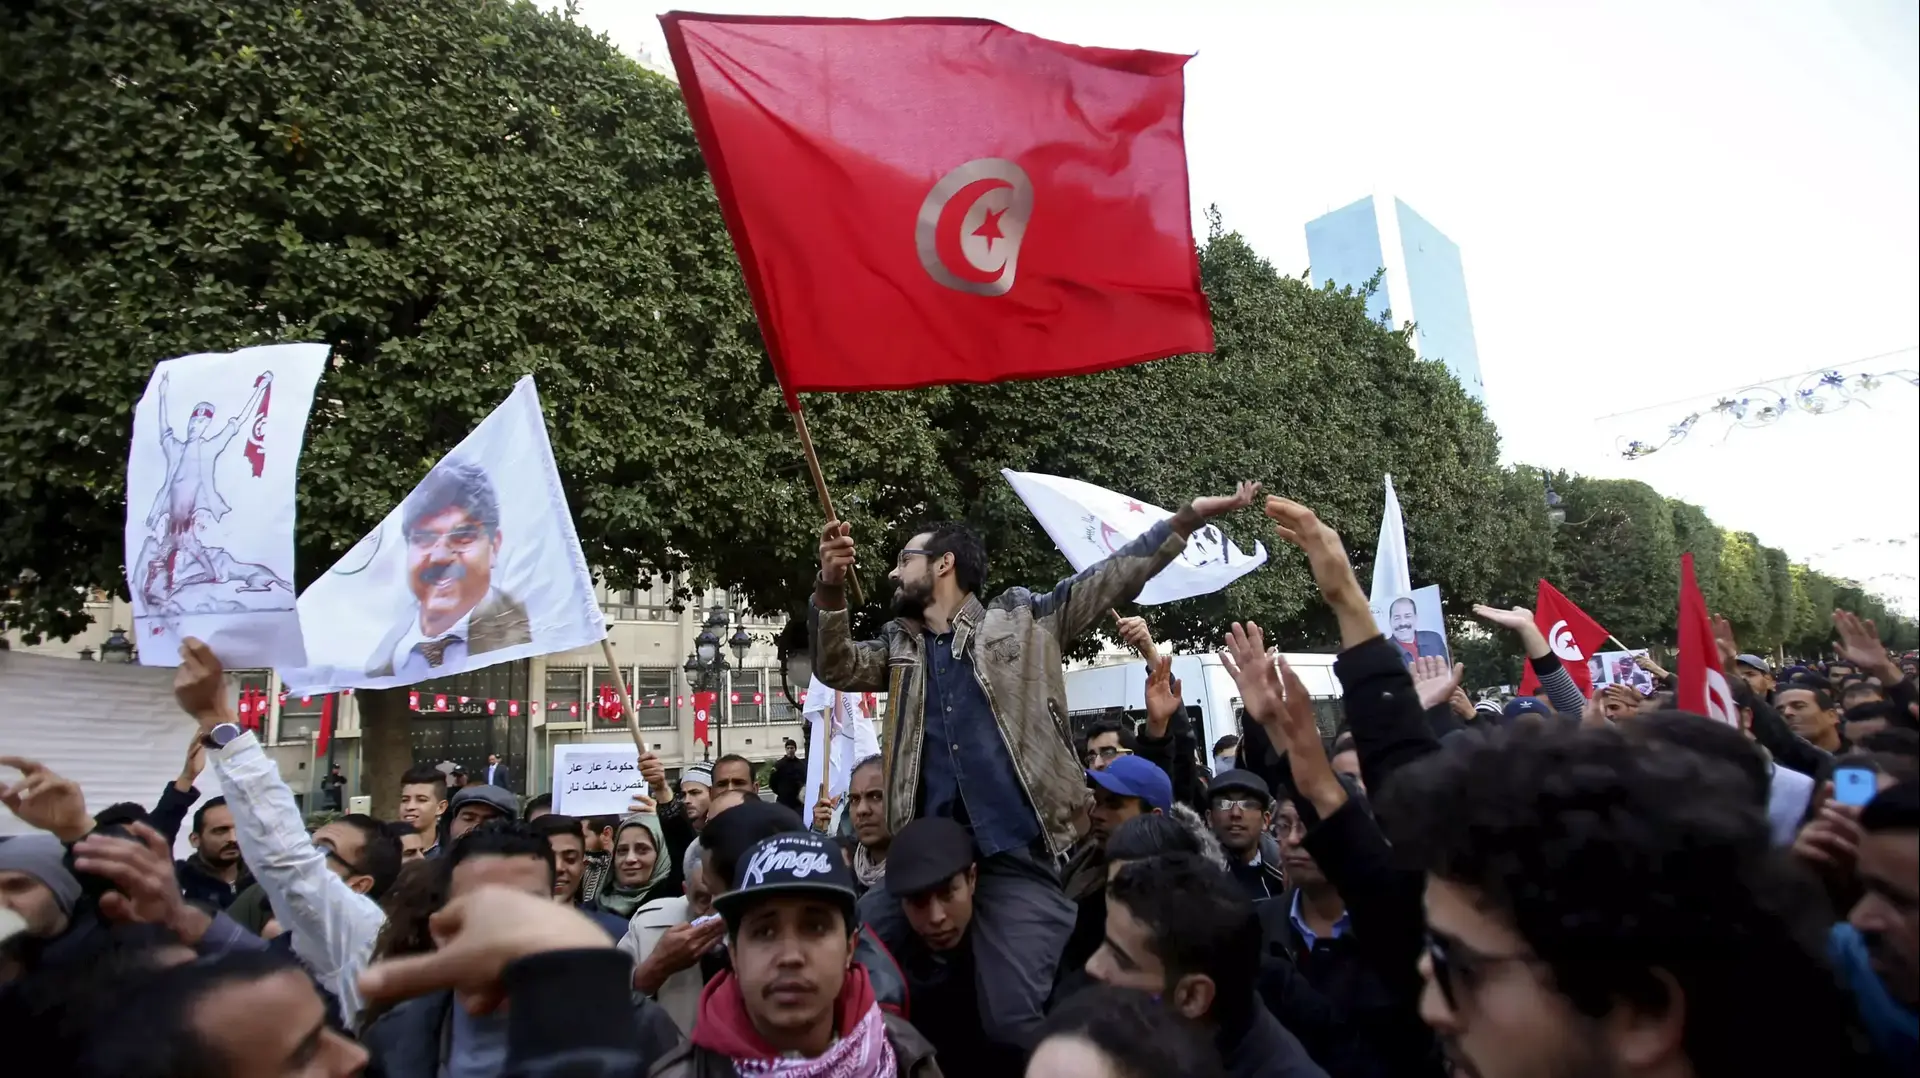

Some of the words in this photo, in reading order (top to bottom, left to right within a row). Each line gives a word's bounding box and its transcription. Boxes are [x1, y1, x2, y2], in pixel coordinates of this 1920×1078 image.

[459, 703, 482, 714] وزارة
[566, 763, 582, 775] عار
[587, 762, 602, 774] عار
[605, 760, 634, 773] حكومة
[566, 782, 579, 794] نار
[582, 780, 607, 791] شعلت
[779, 837, 823, 848] ANGELES
[740, 846, 832, 891] Kings
